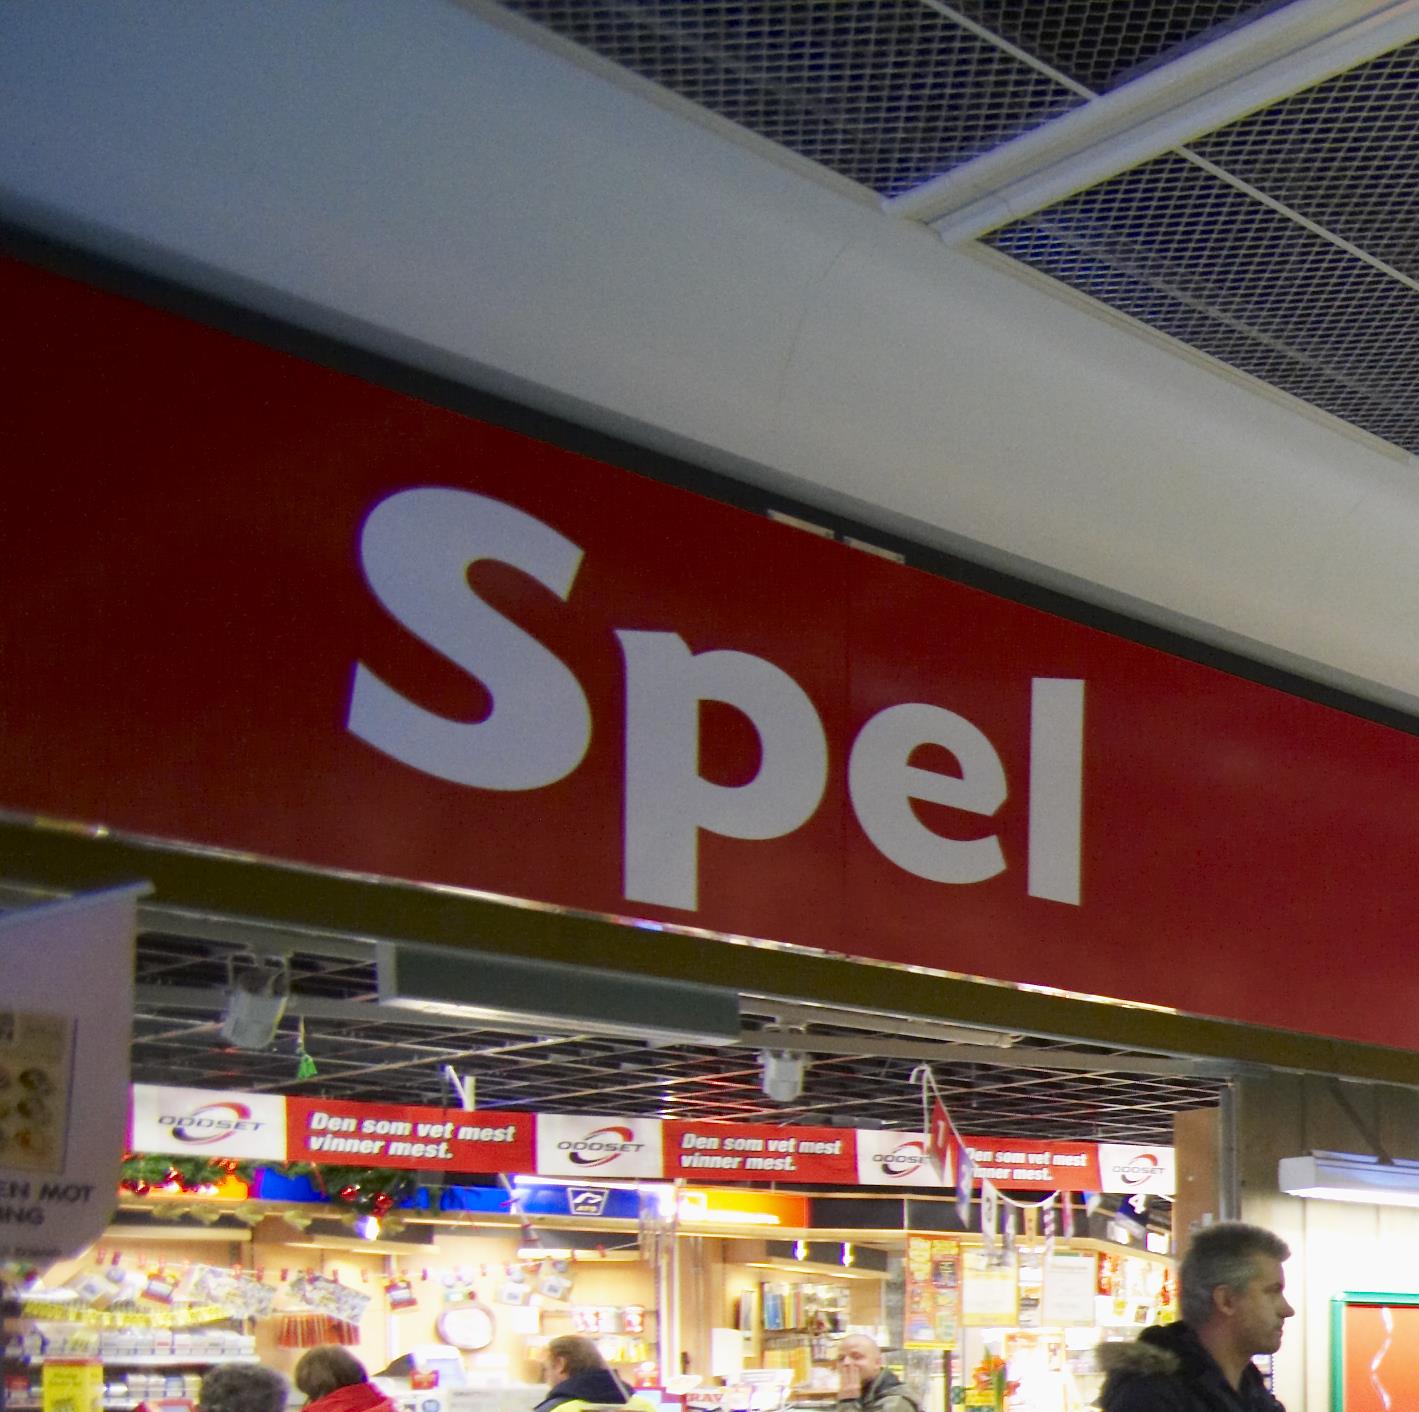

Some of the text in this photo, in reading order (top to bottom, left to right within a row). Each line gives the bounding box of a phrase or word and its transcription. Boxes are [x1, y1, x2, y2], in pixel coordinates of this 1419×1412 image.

[346, 486, 1086, 911] Spel
[158, 1114, 267, 1132] ODDSET
[309, 1111, 516, 1143] Den som vet mest
[309, 1134, 454, 1159] vinner mest.
[556, 1139, 645, 1154] ODDSET
[681, 1132, 842, 1155] Den som vet mest
[680, 1152, 797, 1172] vinner mest.
[995, 1151, 1026, 1164] som
[1027, 1152, 1051, 1165] vet
[1052, 1152, 1088, 1167] mest
[970, 1165, 1054, 1180] inner mest.
[40, 1184, 96, 1203] MOT
[1127, 1192, 1148, 1215] 4
